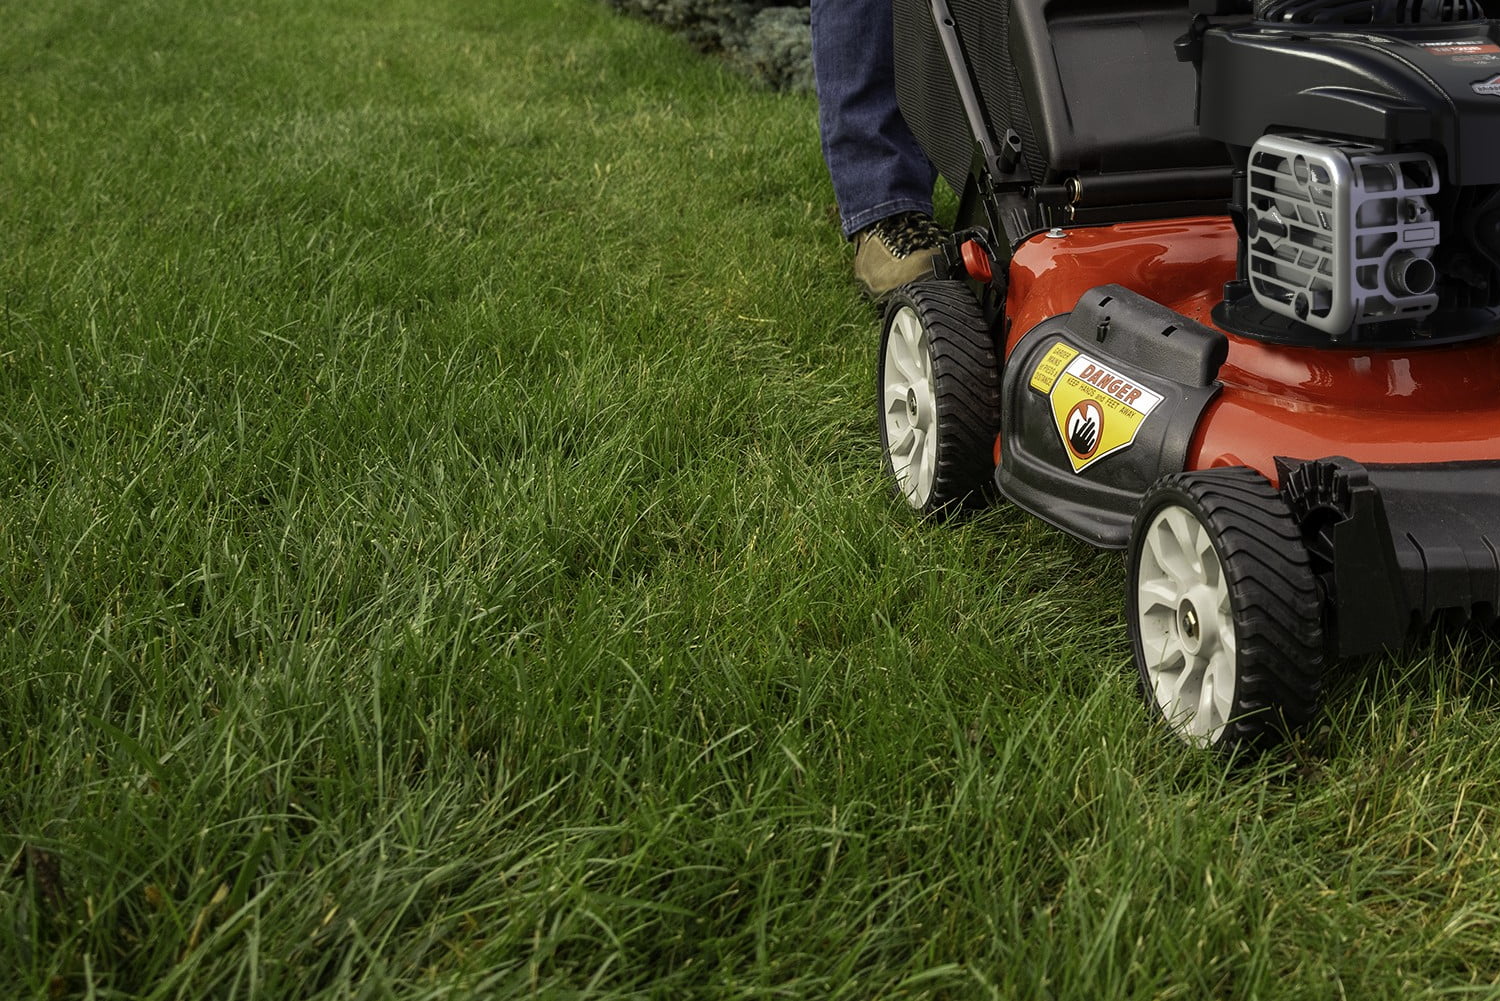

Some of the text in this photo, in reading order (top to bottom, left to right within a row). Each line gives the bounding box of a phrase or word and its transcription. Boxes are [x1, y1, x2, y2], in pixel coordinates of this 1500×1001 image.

[1066, 378, 1136, 418] KEEP HANDS and FEET AWAY
[1080, 364, 1143, 406] DANGER
